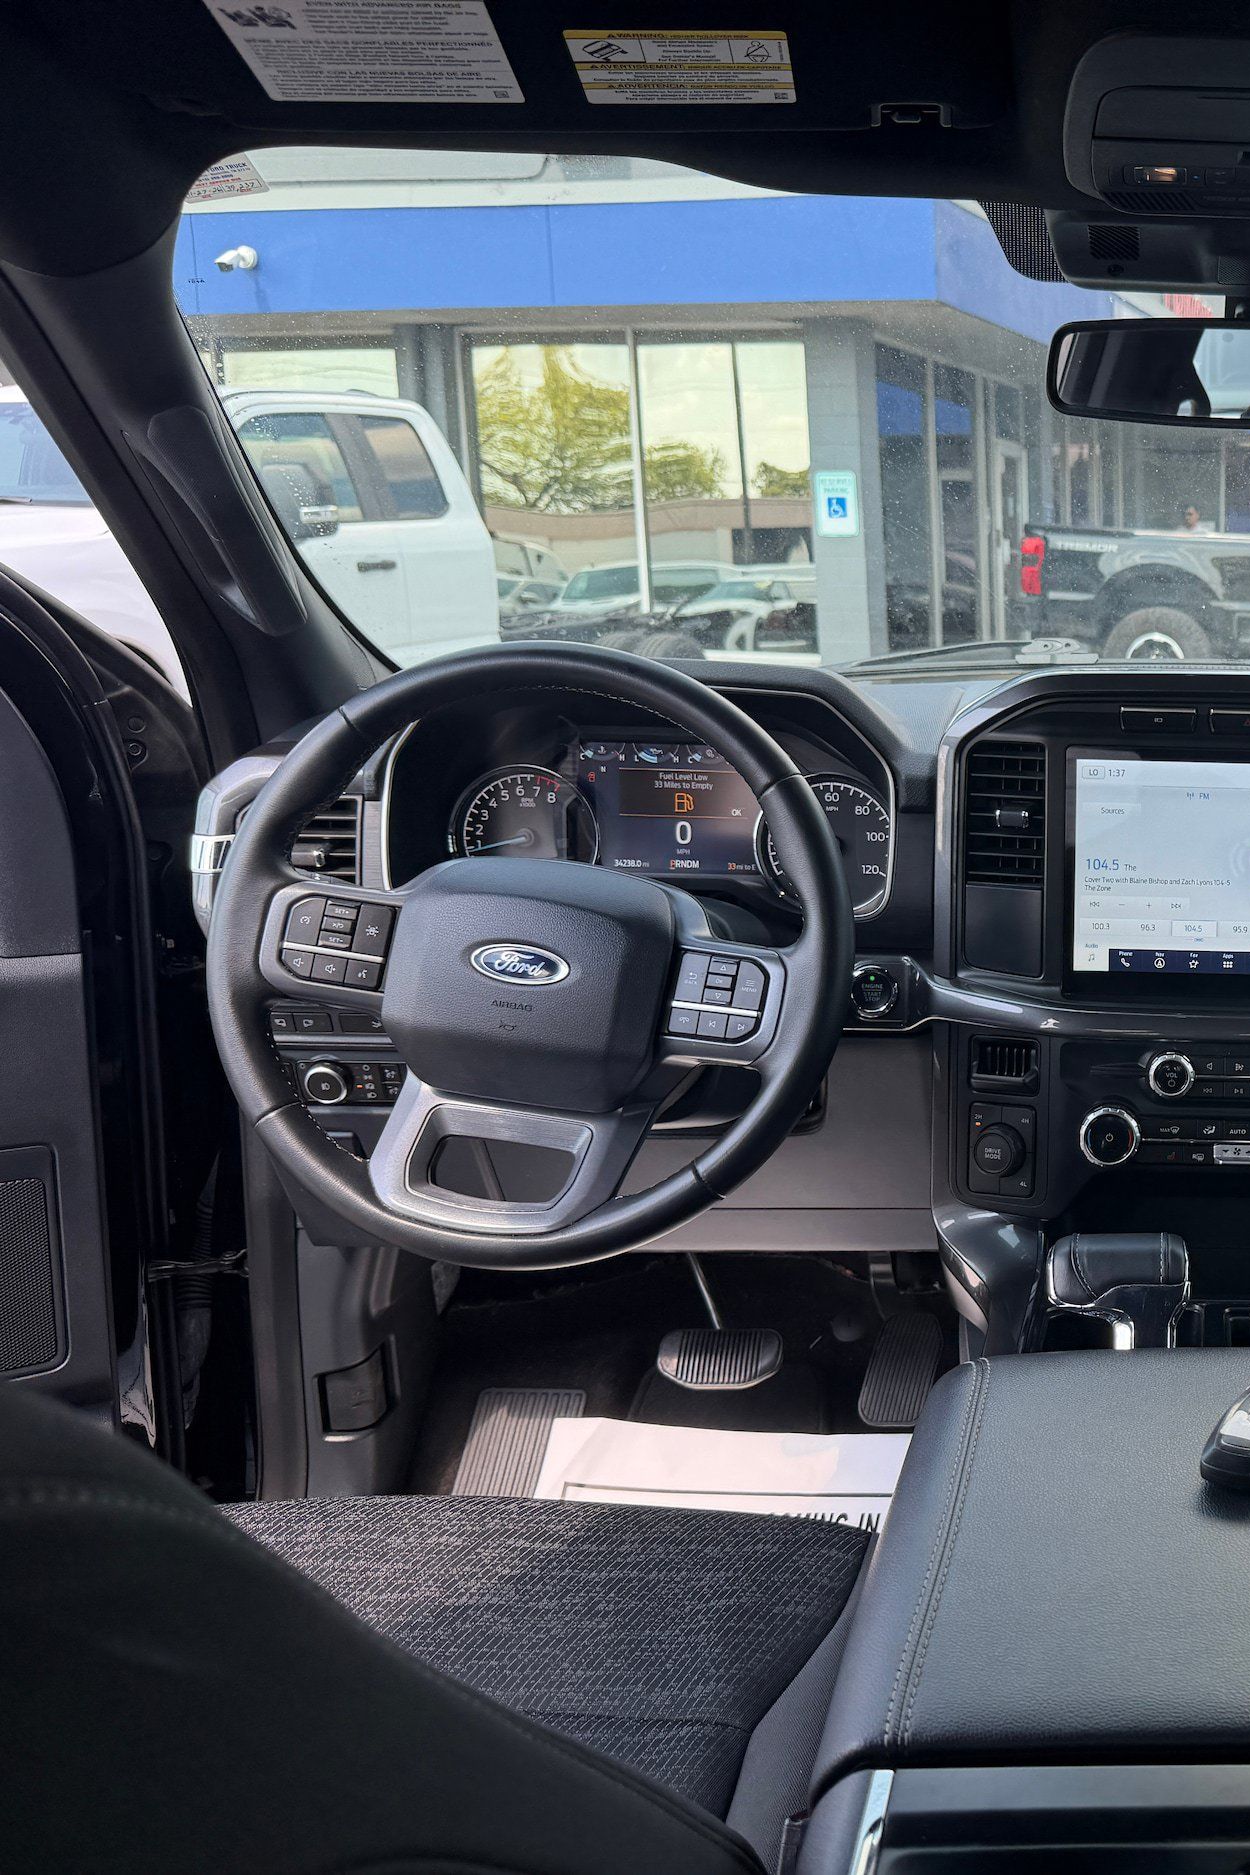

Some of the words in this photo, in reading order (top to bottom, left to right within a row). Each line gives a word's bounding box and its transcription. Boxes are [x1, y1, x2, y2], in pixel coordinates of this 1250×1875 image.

[225, 162, 248, 170] TRUCK
[619, 754, 626, 763] H
[673, 755, 680, 764] H
[659, 773, 674, 781] Fuel
[675, 773, 693, 782] Level
[694, 774, 709, 782] Low
[1088, 768, 1099, 777] LO
[1108, 768, 1126, 778] 1:37
[516, 785, 525, 797] 6
[533, 786, 541, 798] 7
[654, 781, 663, 790] 33
[664, 782, 682, 790] Miles
[692, 782, 714, 792] Empty
[501, 790, 510, 802] 5
[547, 792, 557, 804] 8
[824, 792, 840, 803] 60
[1199, 792, 1210, 800] FM
[488, 797, 498, 809] 4
[480, 809, 489, 821] 3
[731, 809, 742, 817] OK
[855, 805, 870, 816] 80
[1100, 806, 1125, 815] Sources
[475, 823, 484, 836] 2
[675, 821, 692, 845] 0
[866, 831, 886, 842] 100
[614, 859, 642, 868] 34238.0
[669, 860, 700, 870] PRNDM
[727, 862, 736, 871] 33
[1086, 858, 1120, 871] 104.5
[1124, 863, 1137, 872] The
[861, 865, 880, 876] 120
[1084, 876, 1101, 884] Cover
[1102, 876, 1115, 885] Two
[1115, 877, 1128, 885] with
[1129, 877, 1148, 885] Blaine
[1148, 877, 1169, 887] Bishop
[1169, 878, 1180, 886] and
[1181, 878, 1196, 886] Zach
[1097, 885, 1111, 893] Zone
[1091, 922, 1110, 931] 100.3
[1140, 924, 1156, 932] 96.3
[1184, 925, 1202, 933] 104.5
[1232, 925, 1248, 934] 95.9
[494, 950, 546, 976] Ford
[491, 1000, 533, 1012] AIRBAG
[1229, 1128, 1247, 1136] AUTO
